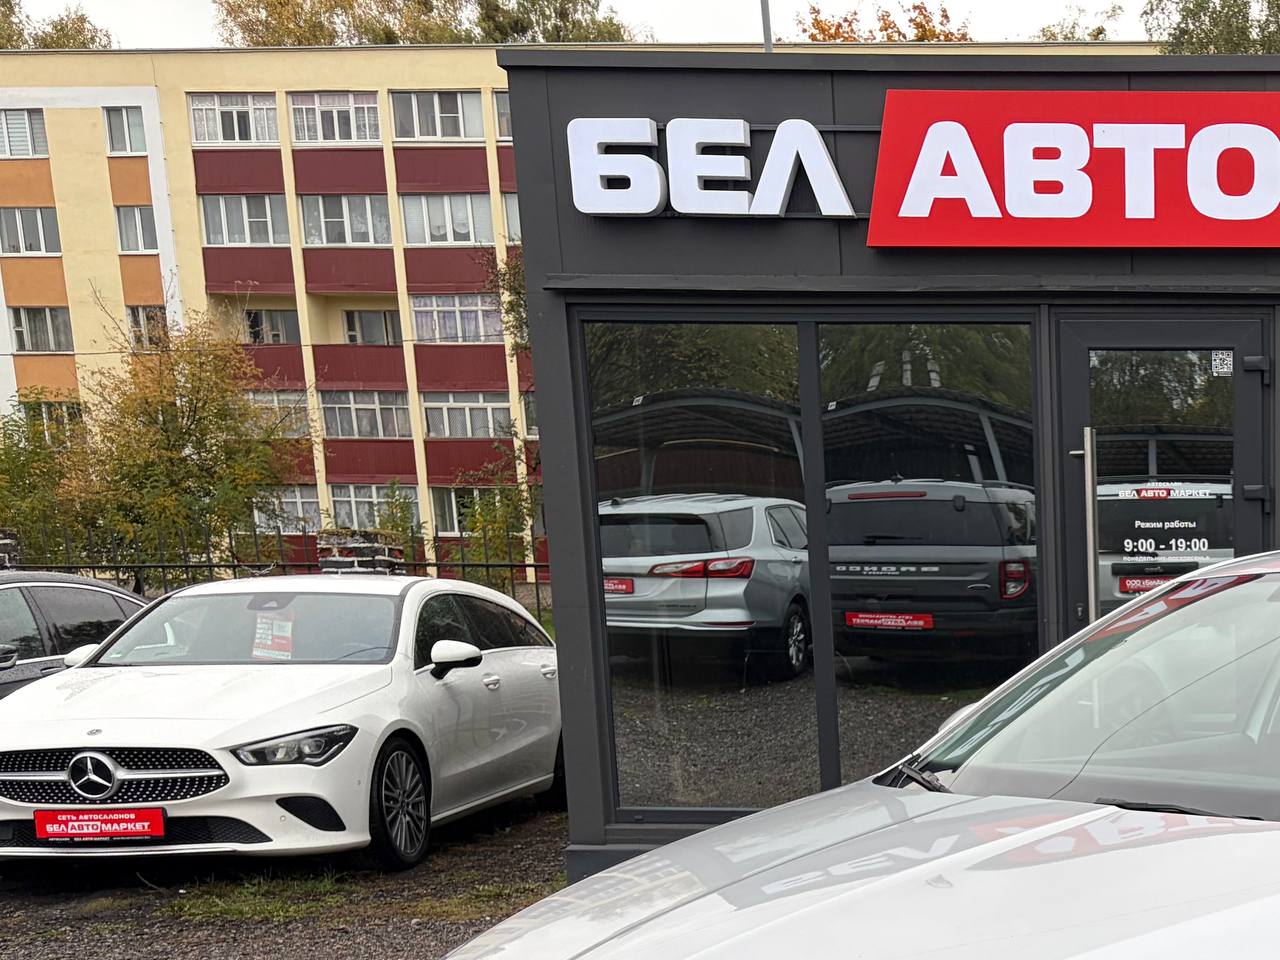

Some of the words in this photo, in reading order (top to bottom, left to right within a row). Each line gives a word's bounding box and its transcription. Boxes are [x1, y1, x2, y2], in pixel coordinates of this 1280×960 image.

[567, 118, 857, 217] БЕЛ
[1140, 489, 1167, 497] АВТО
[1170, 489, 1210, 497] МАРКЕТ
[1164, 520, 1196, 529] работы
[1124, 539, 1155, 552] 9:00
[1169, 538, 1208, 551] 19:00
[46, 824, 66, 832] БЕЛ
[69, 823, 99, 832] АВТО
[101, 822, 150, 831] МАРКЕТ
